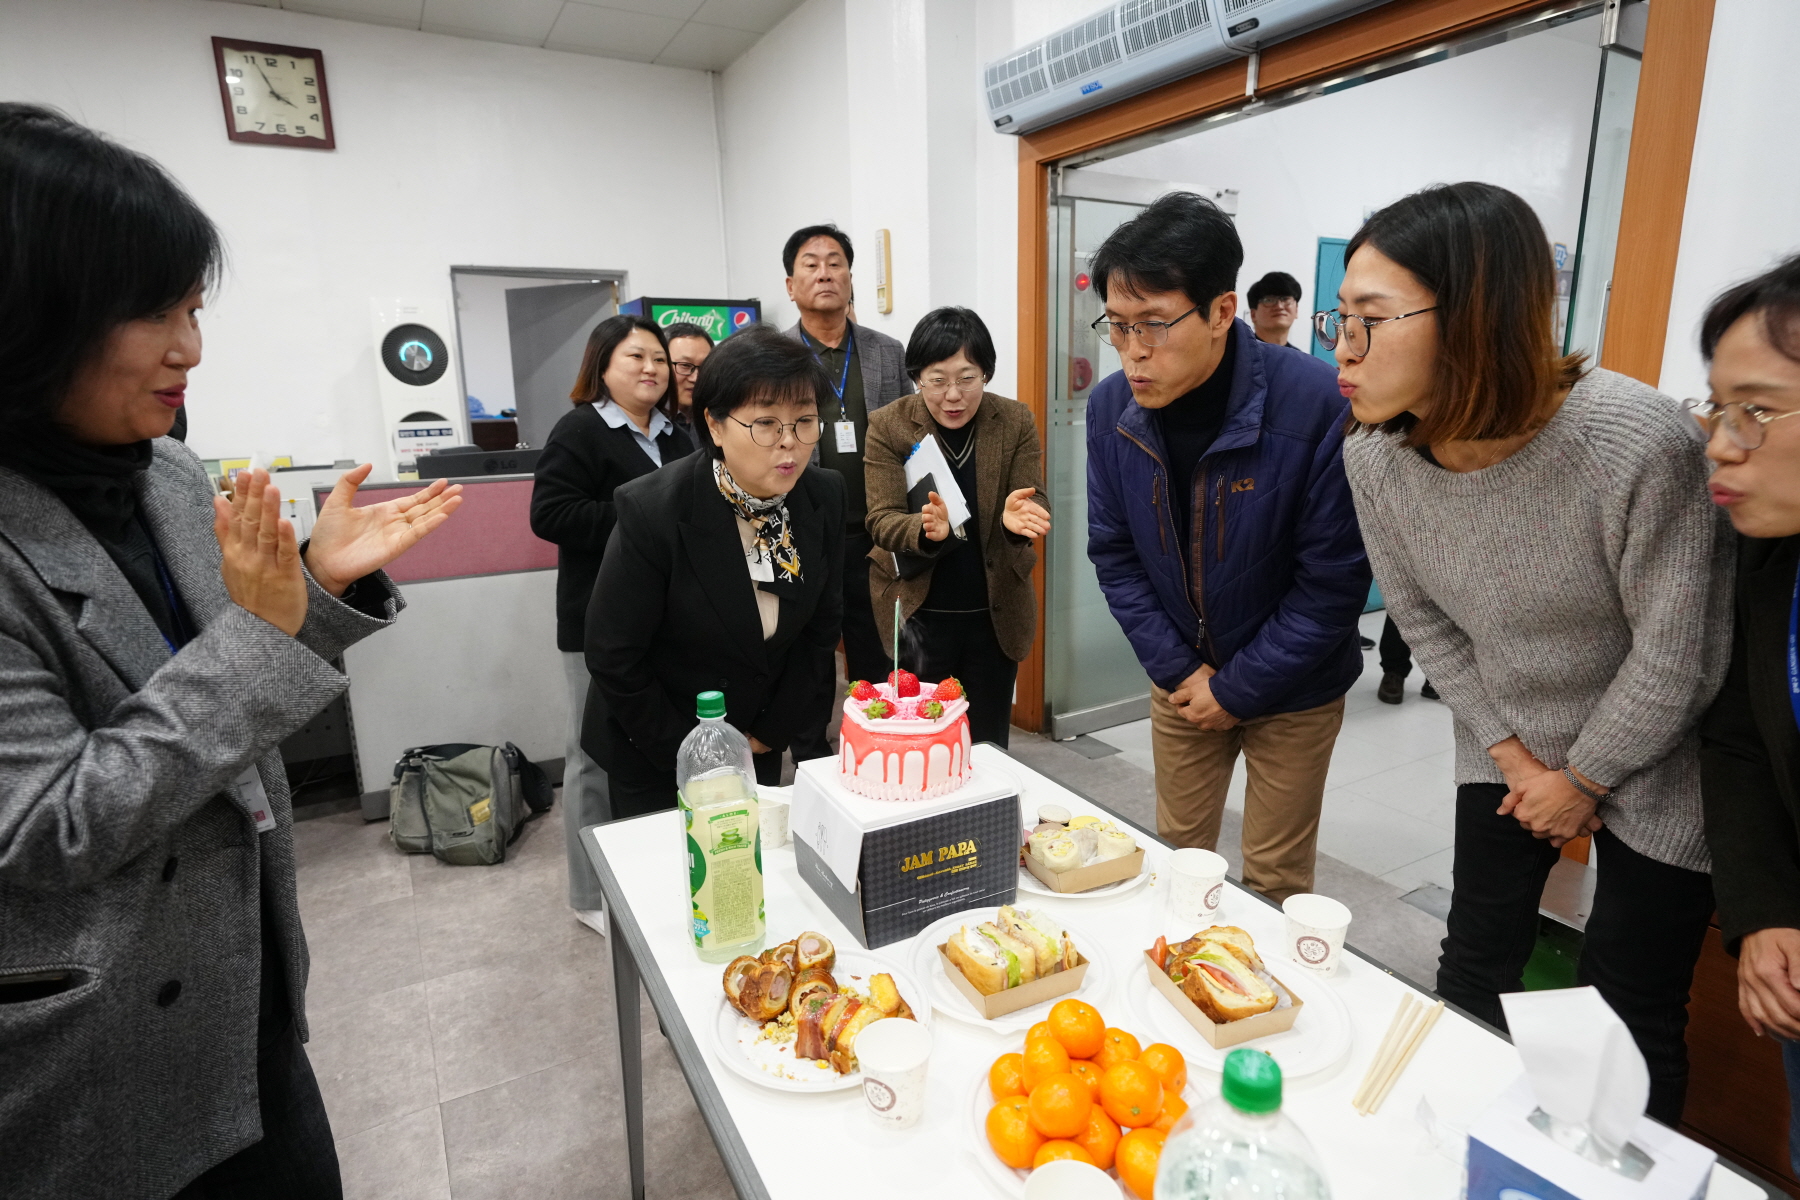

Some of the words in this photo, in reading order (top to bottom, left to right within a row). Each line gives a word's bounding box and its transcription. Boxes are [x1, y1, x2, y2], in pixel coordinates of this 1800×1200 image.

[243, 55, 256, 65] 11
[264, 57, 278, 67] 12
[290, 61, 296, 69] 1
[230, 68, 243, 78] 10
[304, 77, 315, 86] 2
[233, 87, 244, 96] 9
[306, 94, 317, 104] 3
[236, 106, 248, 115] 8
[310, 113, 319, 122] 4
[255, 122, 265, 130] 7
[276, 124, 287, 133] 6
[295, 126, 306, 134] 5
[658, 309, 715, 332] Chilsung
[501, 460, 518, 470] LG
[1231, 478, 1255, 493] K2
[901, 850, 933, 872] JAM
[938, 839, 977, 862] PAPA
